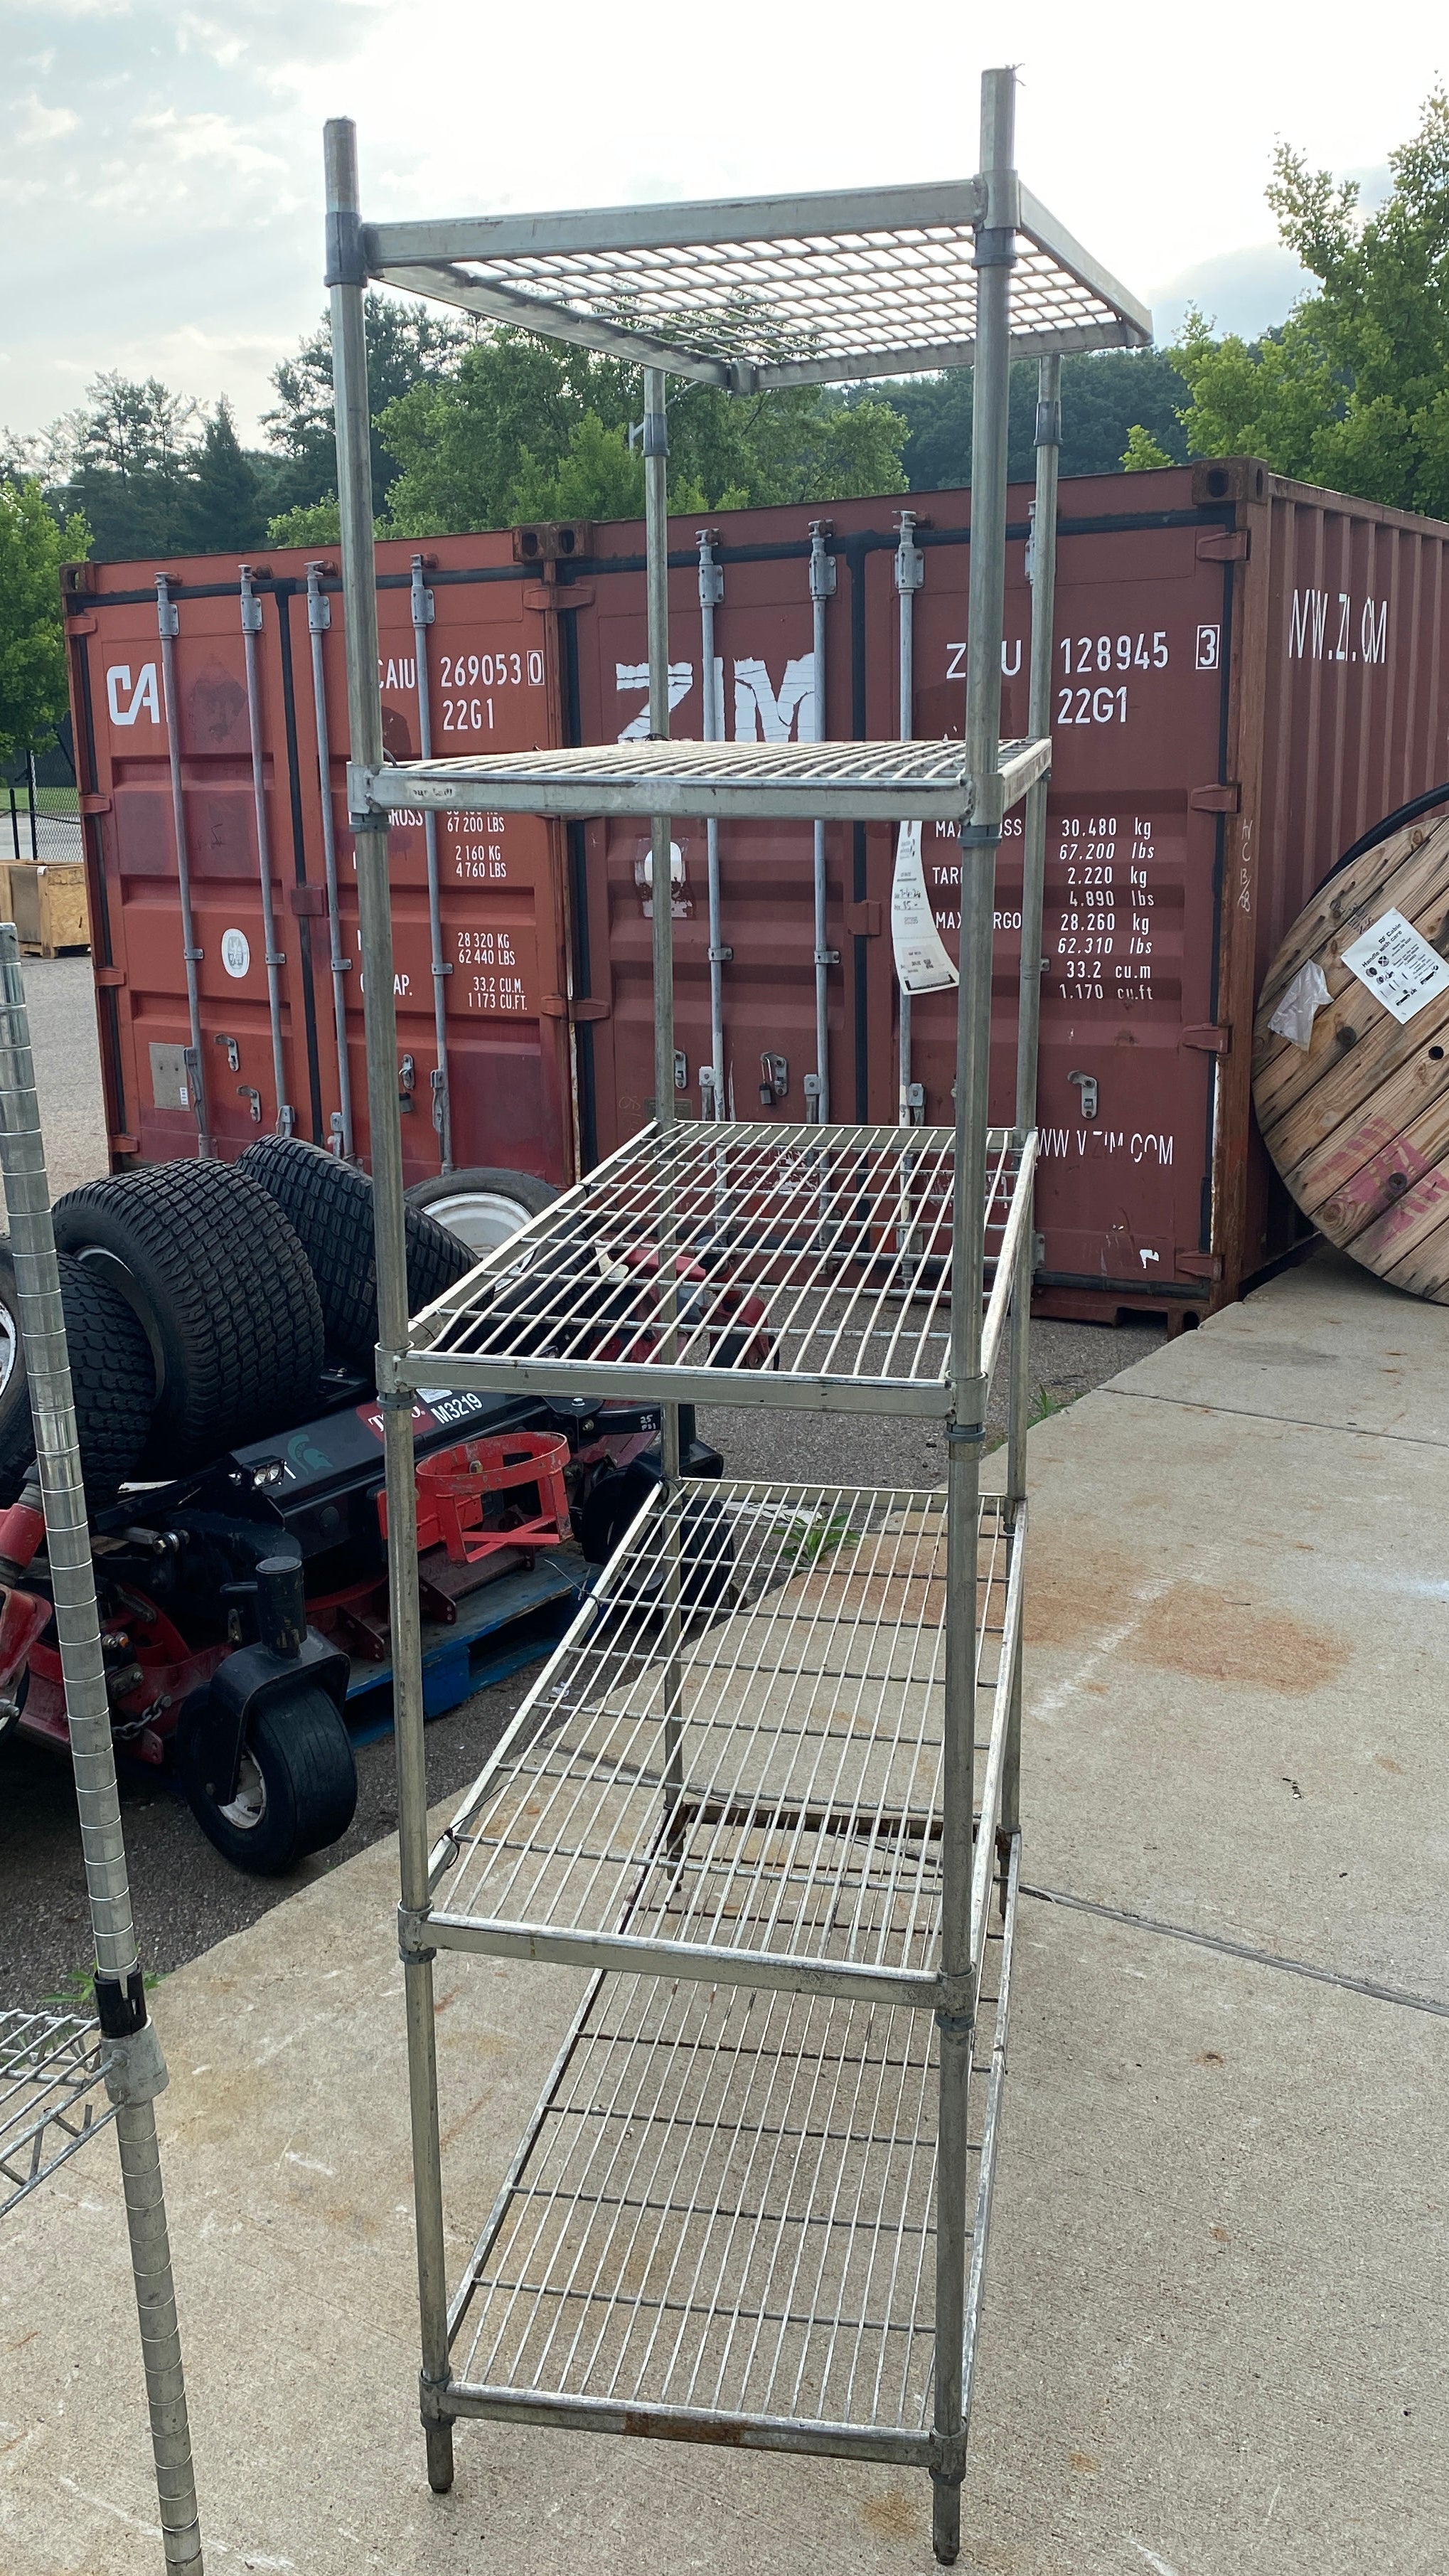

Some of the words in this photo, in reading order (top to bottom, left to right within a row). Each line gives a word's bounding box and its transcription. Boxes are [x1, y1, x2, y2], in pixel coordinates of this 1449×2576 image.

[1060, 632, 1169, 674] 128945
[1199, 629, 1217, 666] 3
[440, 653, 522, 688] 269053
[107, 662, 169, 725] CA
[442, 698, 494, 730] 22G1
[1057, 686, 1127, 724] 22G1
[388, 809, 424, 826] ROSS
[447, 817, 460, 832] 67
[463, 817, 483, 832] 200
[487, 817, 506, 833] LBS
[1061, 818, 1117, 837] 30.480
[1135, 817, 1152, 840] kg
[488, 845, 501, 861] KG
[1059, 843, 1116, 861] 67.200
[1131, 842, 1155, 859] lbs
[489, 862, 507, 878] LBS
[932, 867, 963, 884] TAR
[1067, 866, 1113, 885] 2.220
[1130, 866, 1148, 888] kg
[1069, 890, 1115, 908] 4.890
[1131, 890, 1155, 906] lbs
[1060, 912, 1116, 932] 28.260
[1132, 912, 1150, 935] kg
[457, 932, 471, 948] 28
[474, 932, 493, 948] 320
[497, 933, 510, 949] KG
[1057, 937, 1113, 954] 62.310
[1129, 937, 1153, 954] lbs
[459, 949, 472, 964] 62
[474, 949, 494, 965] 440
[498, 950, 515, 966] LBS
[1066, 961, 1101, 979] 33.2
[1115, 964, 1151, 979] cu.m
[393, 974, 413, 996] AP.
[473, 976, 496, 993] 33.2
[499, 977, 525, 994] CU.M.
[1059, 984, 1103, 1000] 1.170
[499, 994, 528, 1011] CU.FT.
[430, 1393, 483, 1425] M3219
[640, 1414, 653, 1424] 25
